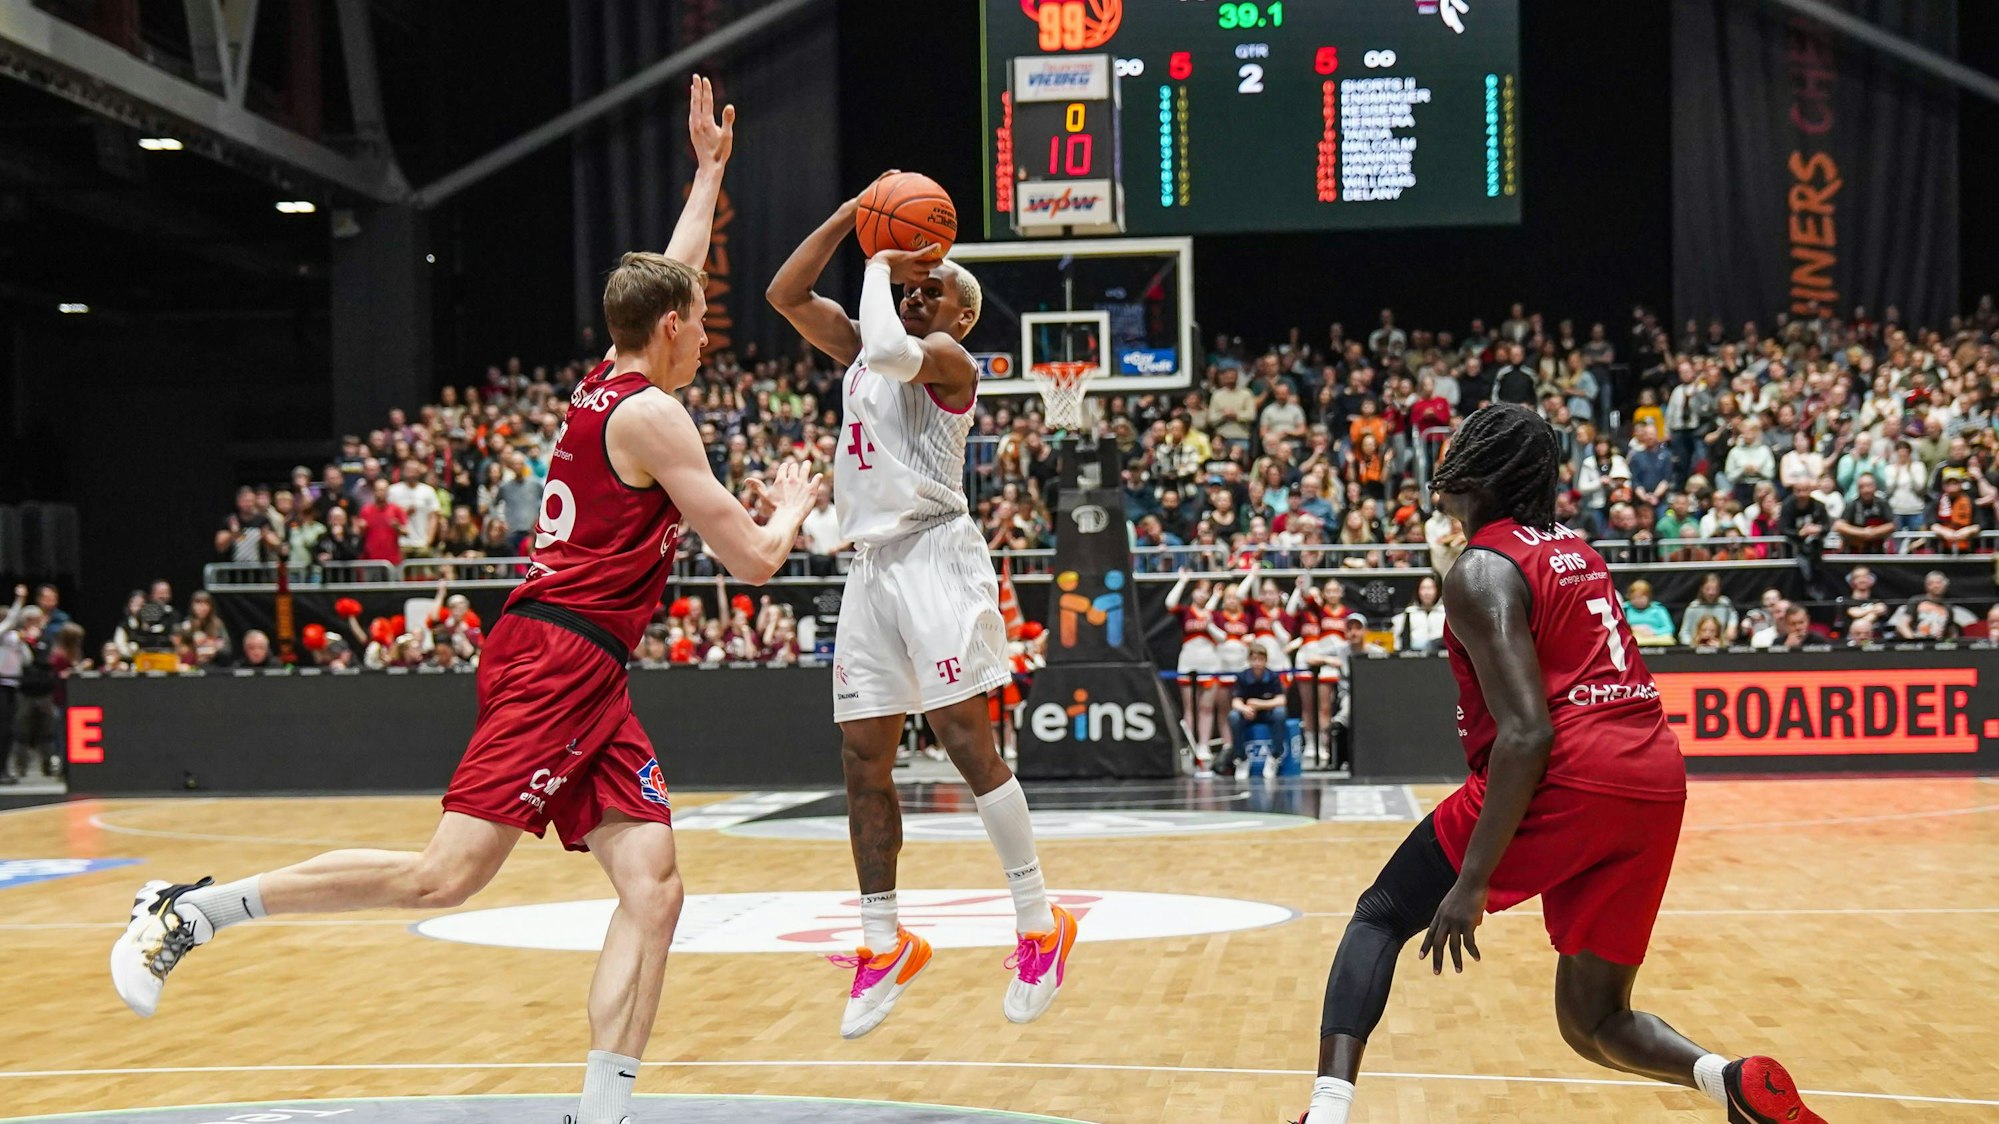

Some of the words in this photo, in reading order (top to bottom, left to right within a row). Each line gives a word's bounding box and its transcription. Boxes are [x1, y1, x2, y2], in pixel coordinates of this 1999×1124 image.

[1038, 2, 1086, 51] 99
[1218, 2, 1282, 29] 39.1
[1234, 43, 1269, 59] QTR
[1315, 46, 1338, 75] 5
[1169, 52, 1192, 80] 5
[1238, 64, 1264, 93] 2
[1066, 103, 1086, 132] 0
[1049, 133, 1092, 175] 10
[1342, 187, 1404, 201] DELANY
[553, 446, 573, 462] achsen
[1549, 548, 1587, 574] eins
[1586, 597, 1626, 672] 7
[1031, 688, 1156, 741] eins
[67, 706, 104, 763] E
